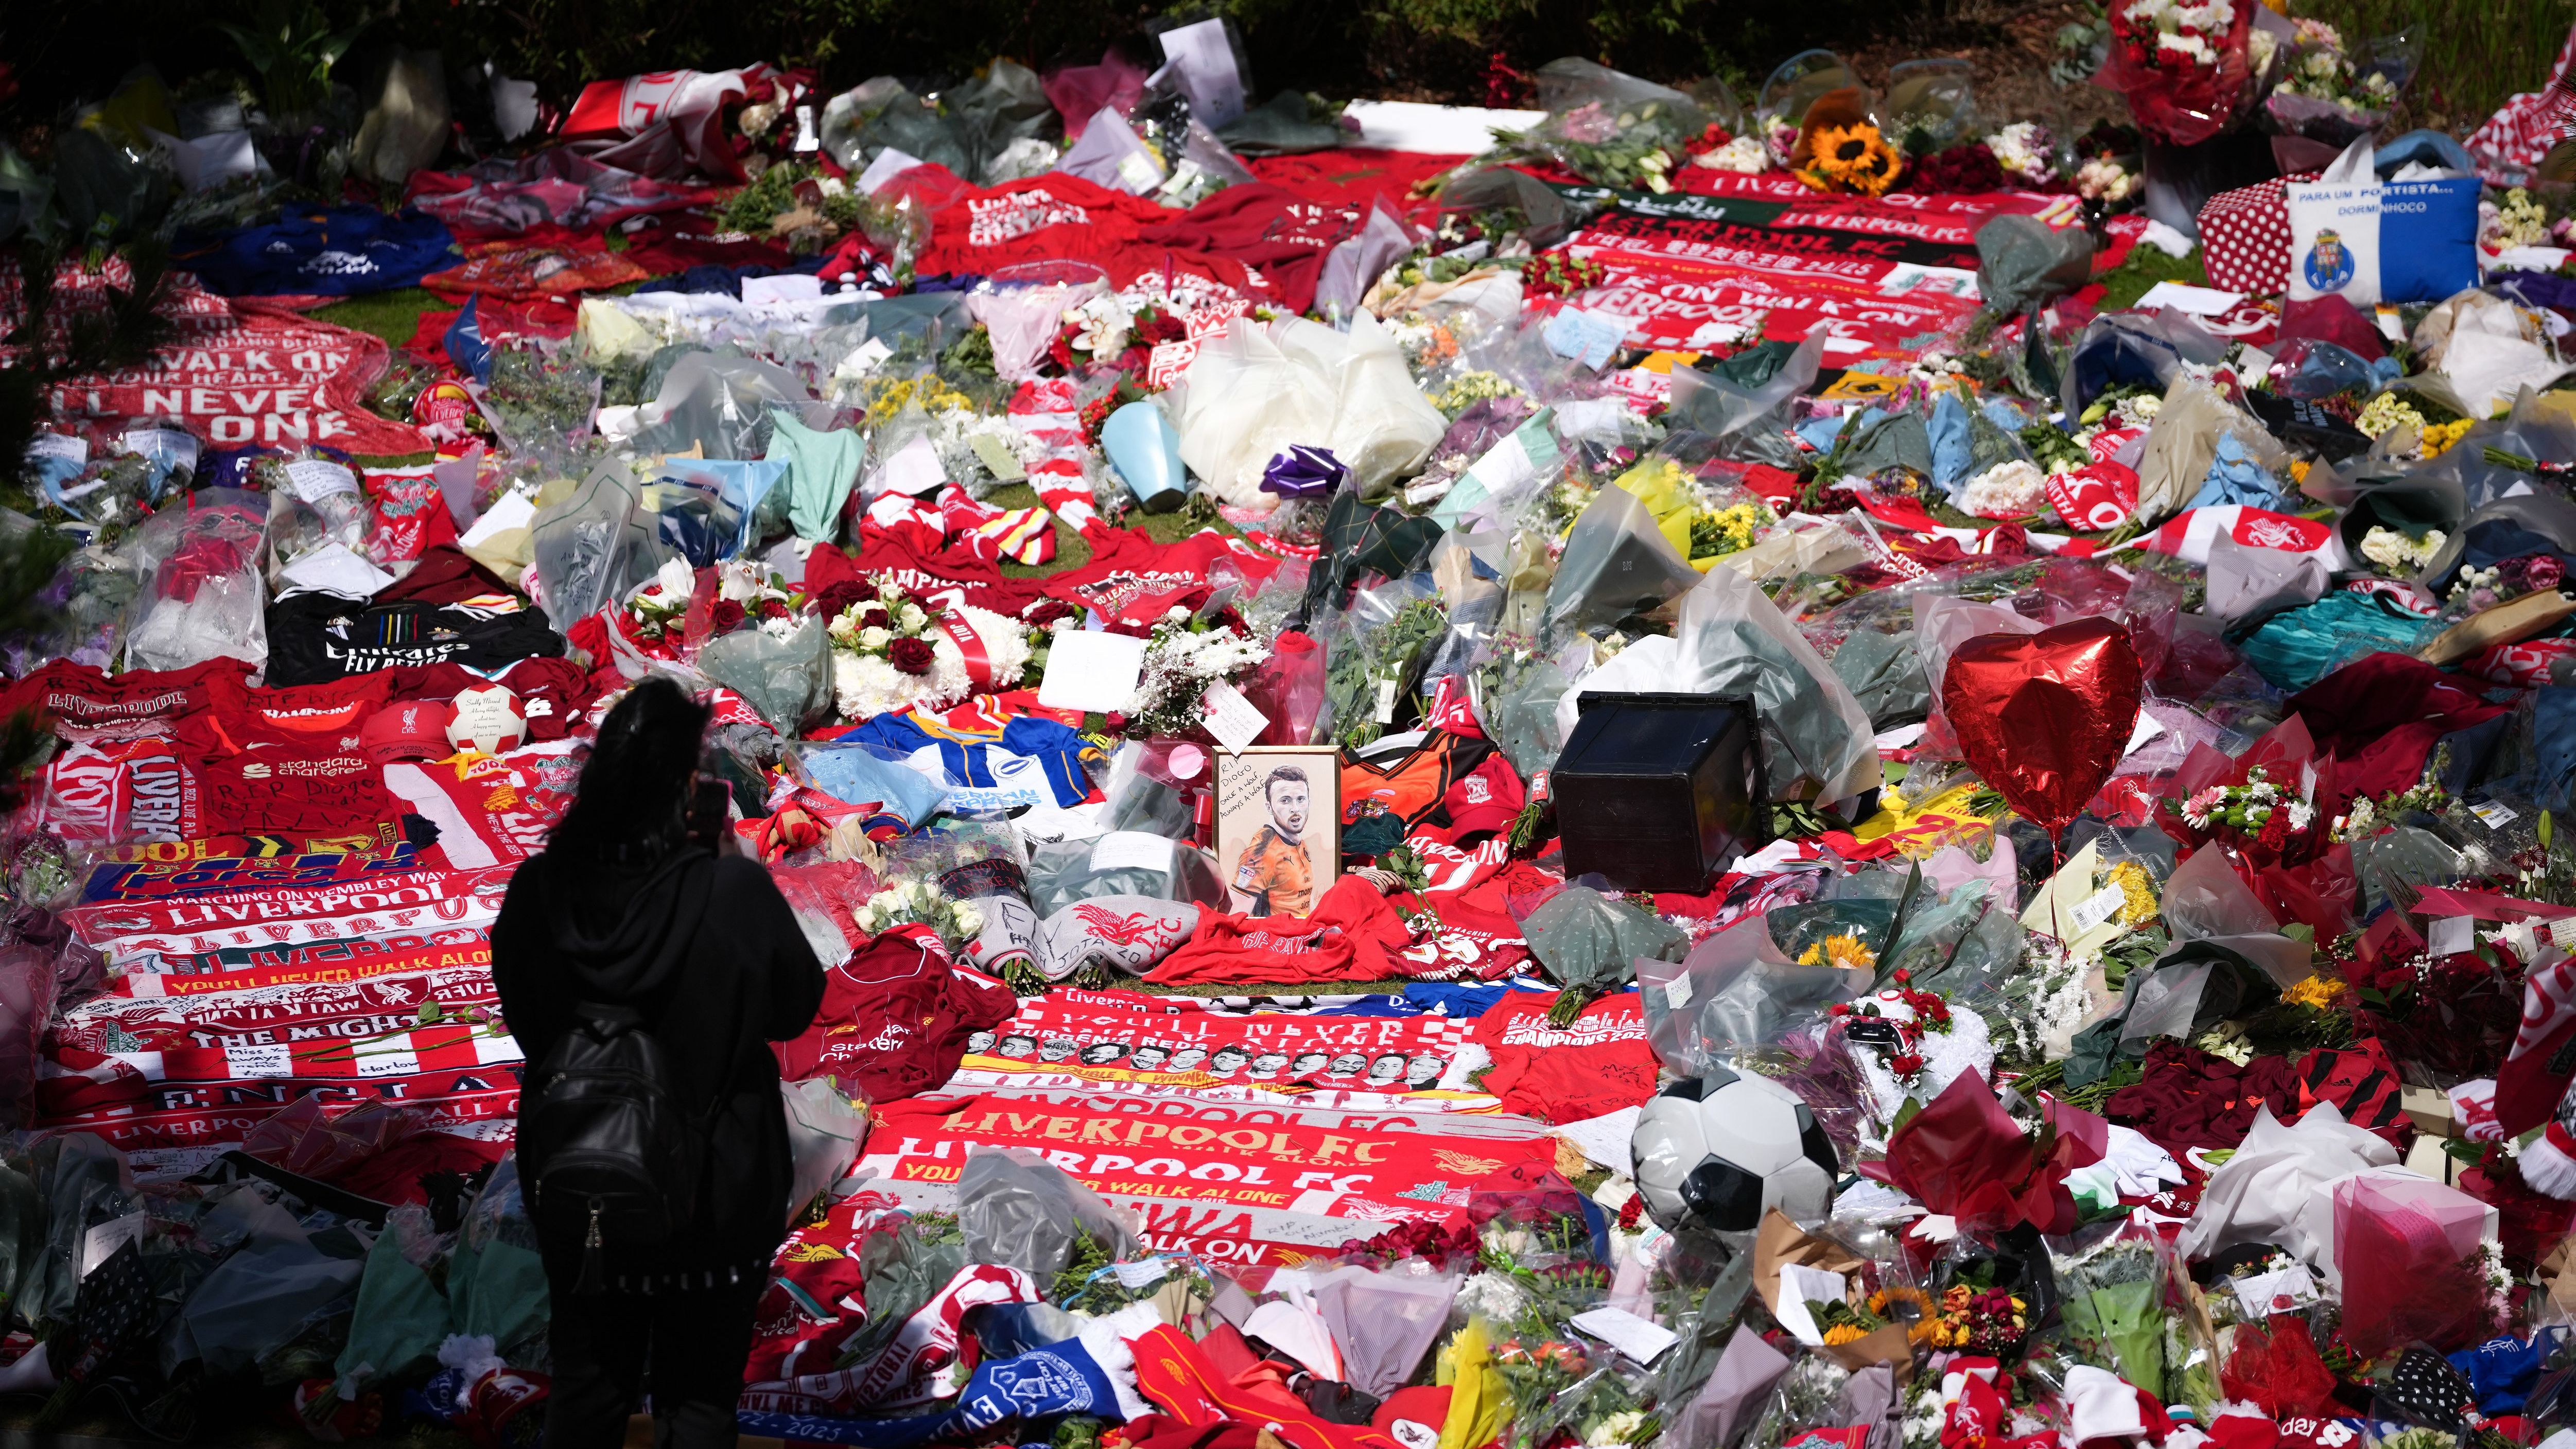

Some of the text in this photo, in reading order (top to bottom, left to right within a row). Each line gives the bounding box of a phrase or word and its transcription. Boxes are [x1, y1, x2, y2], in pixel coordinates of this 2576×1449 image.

[2299, 193, 2331, 203] PARA
[2334, 190, 2353, 199] UM
[2338, 201, 2427, 216] DORMINHOCO
[1783, 212, 1933, 238] LIVERPOOL
[1933, 227, 1969, 241] FC
[1803, 260, 1874, 276] 24/25
[1582, 285, 1870, 337] VERPOOL FC
[147, 349, 350, 373] WALK ON
[2047, 476, 2075, 515] WITH
[1093, 596, 1106, 605] 20
[1106, 581, 1143, 601] LEAGUE
[949, 623, 974, 642] JOTA
[345, 655, 378, 672] FLY
[465, 698, 481, 706] Sadly
[2170, 697, 2189, 707] BEAUTIFUL
[2189, 704, 2205, 717] BLOOMS
[2206, 715, 2226, 730] BEAUTIFUL
[474, 730, 478, 739] of
[279, 757, 362, 769] standard
[279, 763, 368, 777] chartered
[1221, 764, 1252, 788] DIOGO
[941, 789, 1037, 801] MERICAN
[1221, 790, 1237, 806] ONCE
[1245, 771, 1262, 787] WOLF,
[1469, 784, 1487, 798] 20
[1219, 778, 1266, 820] ALWAYS A WOLF
[184, 804, 197, 819] LIVE
[497, 832, 513, 844] THE
[506, 844, 524, 857] BEST
[2108, 825, 2124, 845] BEAUTIFUL
[959, 876, 1011, 898] ANDRE
[2142, 861, 2164, 895] BLOOMS BEAU
[167, 872, 447, 905] MARCHING ON WEMBLEY WAY
[166, 881, 459, 928] LIVERPOOL
[191, 896, 507, 953] LIVERPOO
[1454, 927, 1494, 938] MACHINE
[1116, 947, 1141, 964] 20
[171, 978, 267, 993] YOU'LL
[357, 956, 434, 976] WALK
[440, 950, 493, 966] ALO
[1066, 991, 1136, 1005] Liverp
[189, 1012, 457, 1049] THE MIGHT
[1582, 1024, 1599, 1033] DIJK
[1140, 1036, 1209, 1051] REDS
[1501, 1031, 1610, 1048] CHAMPIONS
[225, 1055, 281, 1063] ALWAYS
[361, 1061, 419, 1073] Harlow
[1052, 1066, 1211, 1083] DOUBLE WINNER
[1313, 1077, 1354, 1089] GRAVENBERCH
[938, 1110, 1398, 1163] LIVERPOOL FC
[898, 1137, 1374, 1194] LIVERPOOL FC
[906, 1162, 1290, 1206] YOU WALK ALONE
[1137, 1232, 1268, 1265] ALK ON
[785, 1421, 842, 1441] 2025
